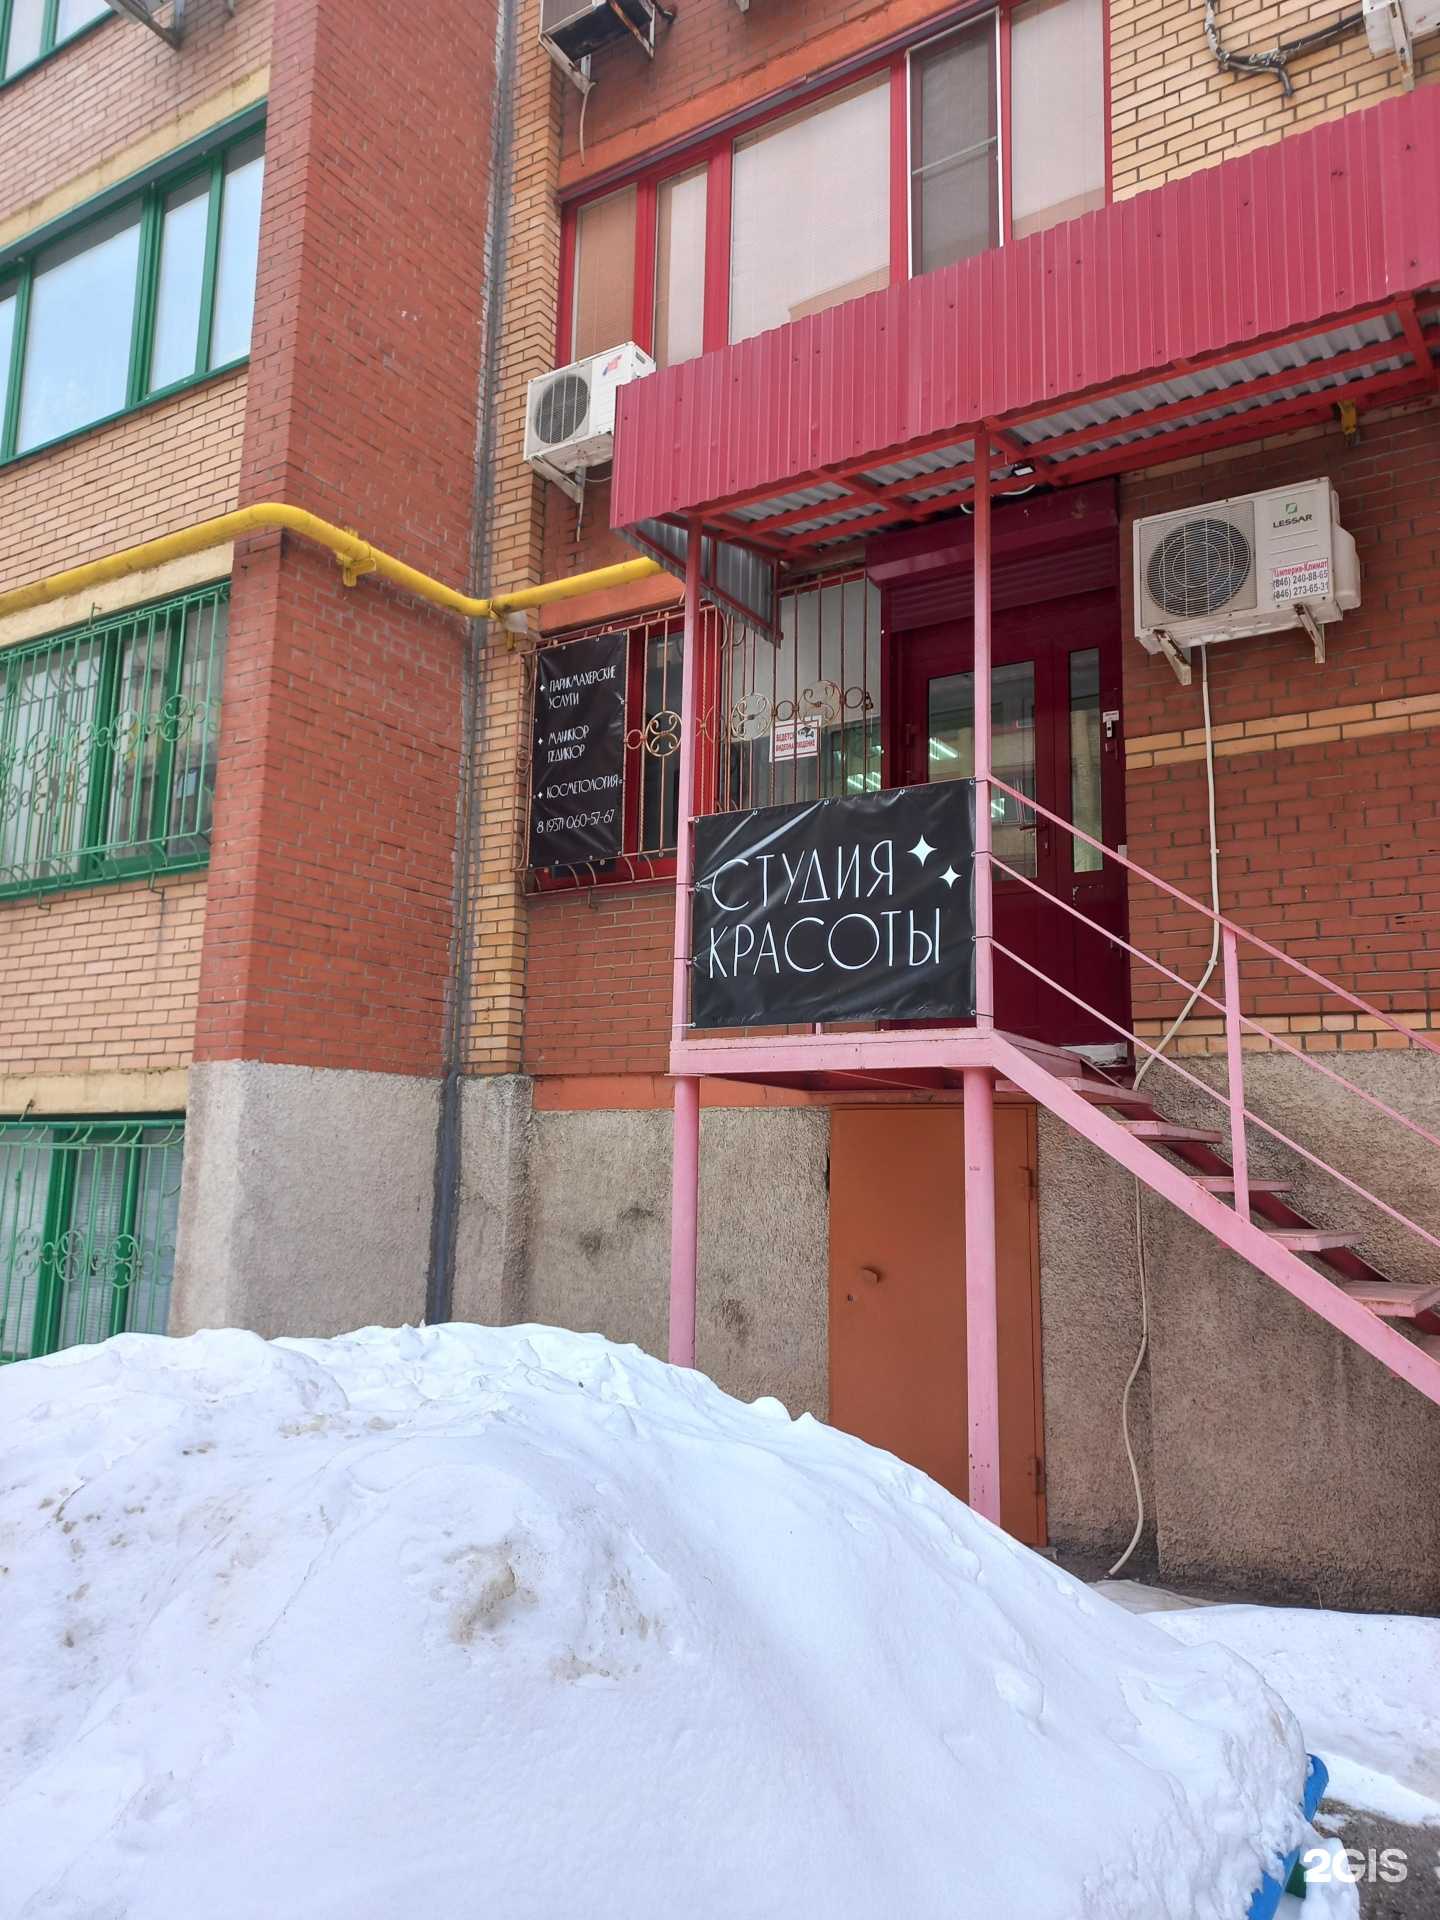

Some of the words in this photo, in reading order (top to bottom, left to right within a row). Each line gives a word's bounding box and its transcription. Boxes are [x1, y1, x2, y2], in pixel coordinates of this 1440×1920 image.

[1272, 514, 1313, 528] LESSAR
[549, 665, 617, 692] ПАРИКМАХЕРСКИЕ
[548, 691, 579, 709] УСЛУГИ
[548, 724, 590, 744] МАНИКЮР
[547, 743, 586, 763] ПЕДИКЮР
[546, 774, 619, 799] КОСМЕТОЛОГИЯ
[536, 820, 544, 834] 8
[566, 809, 615, 830] 060-57-67
[711, 839, 893, 912] СТУДИЯ
[709, 907, 940, 979] КРАСОТЫ
